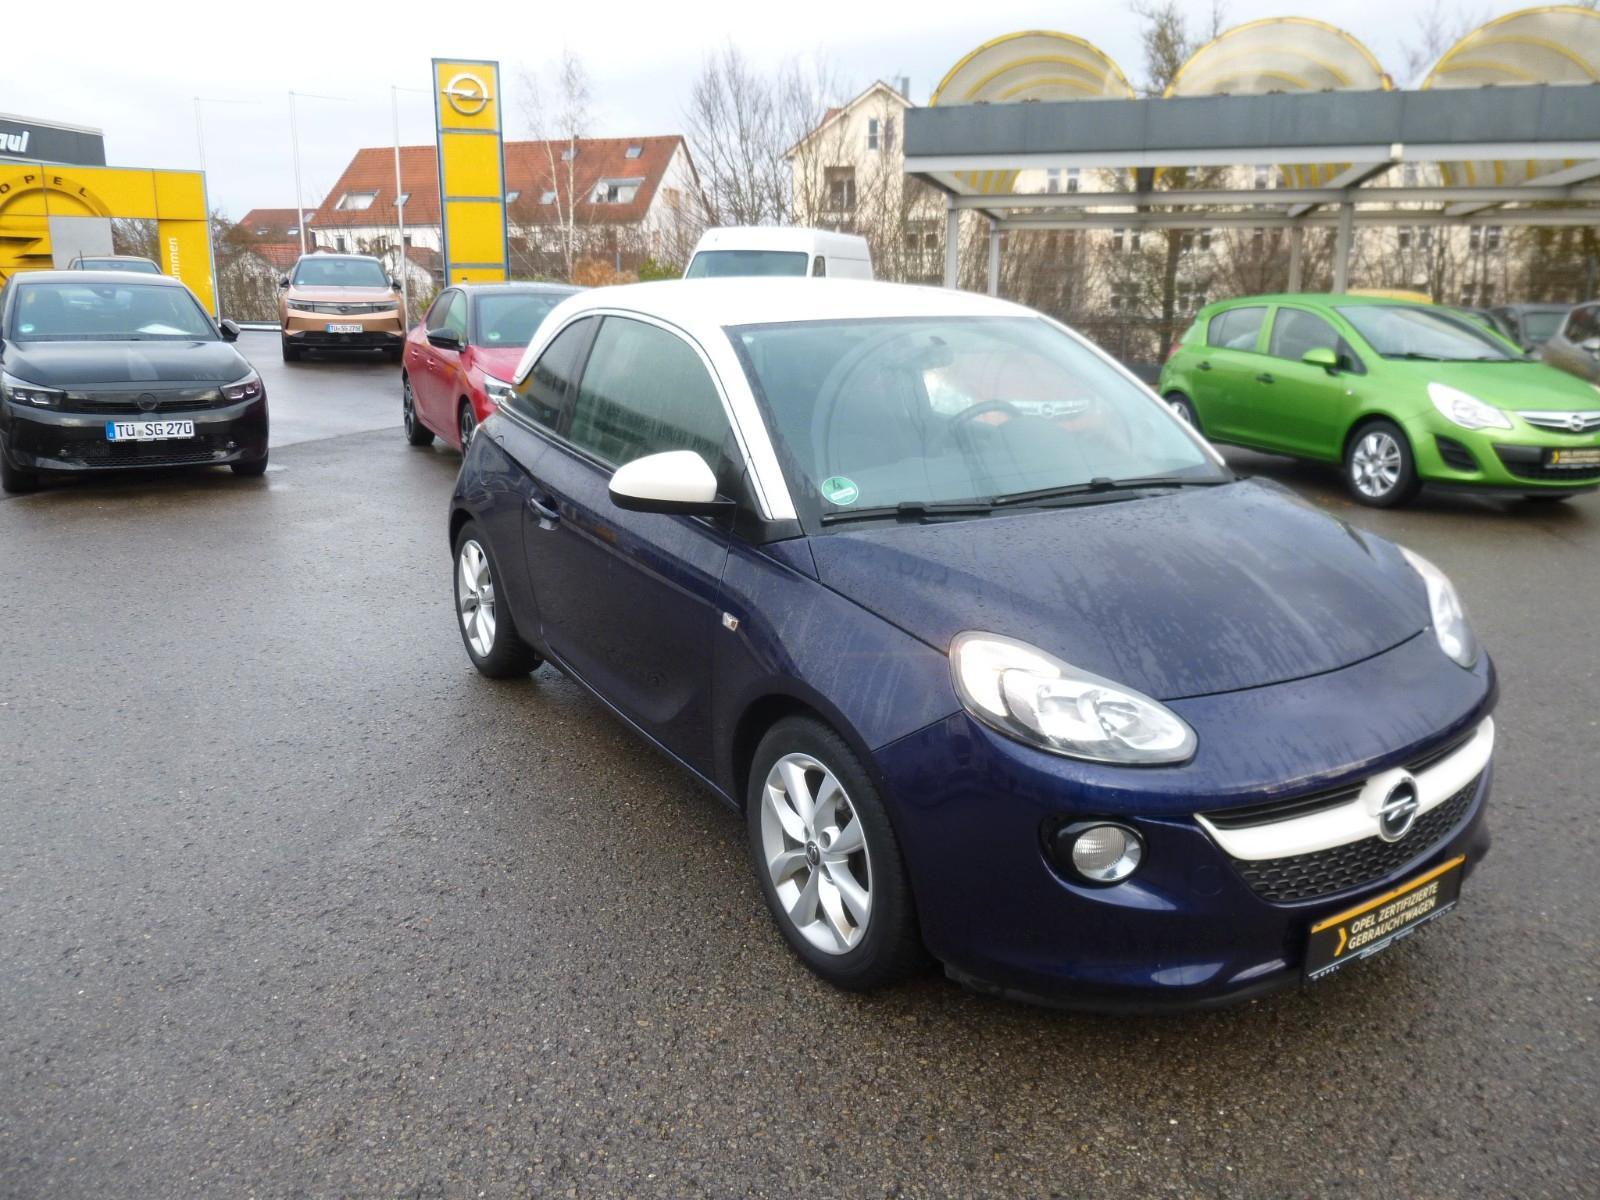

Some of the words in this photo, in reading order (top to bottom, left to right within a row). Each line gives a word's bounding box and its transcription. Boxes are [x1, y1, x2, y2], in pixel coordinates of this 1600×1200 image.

[0, 174, 88, 198] OPEL
[116, 424, 135, 437] TÜ
[145, 423, 164, 436] SG
[166, 422, 192, 435] 270
[1348, 896, 1437, 950] GEBRAUCHTWAGEN
[1351, 914, 1377, 934] OPEL
[1378, 881, 1439, 921] ZERTIFIZIERTE
